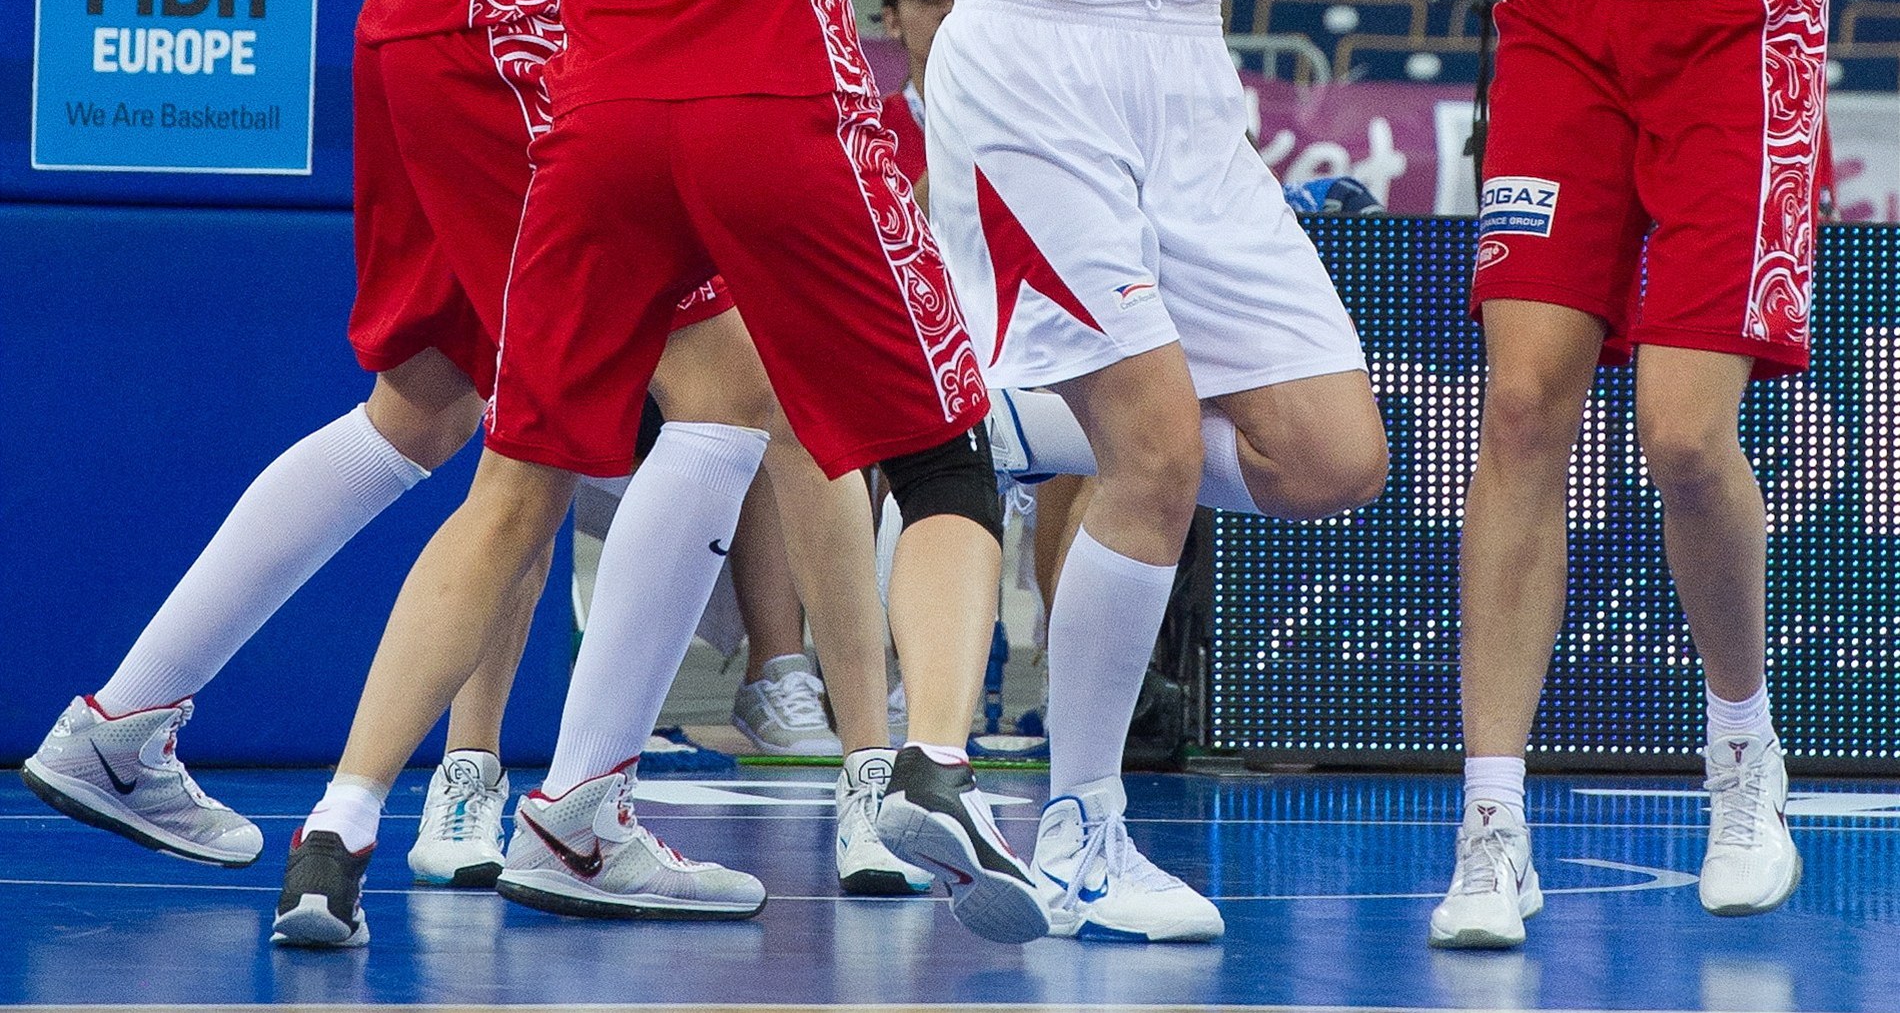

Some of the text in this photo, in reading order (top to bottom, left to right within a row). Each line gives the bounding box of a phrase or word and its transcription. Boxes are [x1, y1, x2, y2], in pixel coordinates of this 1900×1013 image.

[93, 27, 257, 75] EUROPE
[66, 101, 280, 130] We Are Basketball
[1484, 187, 1556, 208] OGAZ
[1509, 217, 1545, 227] GROUP
